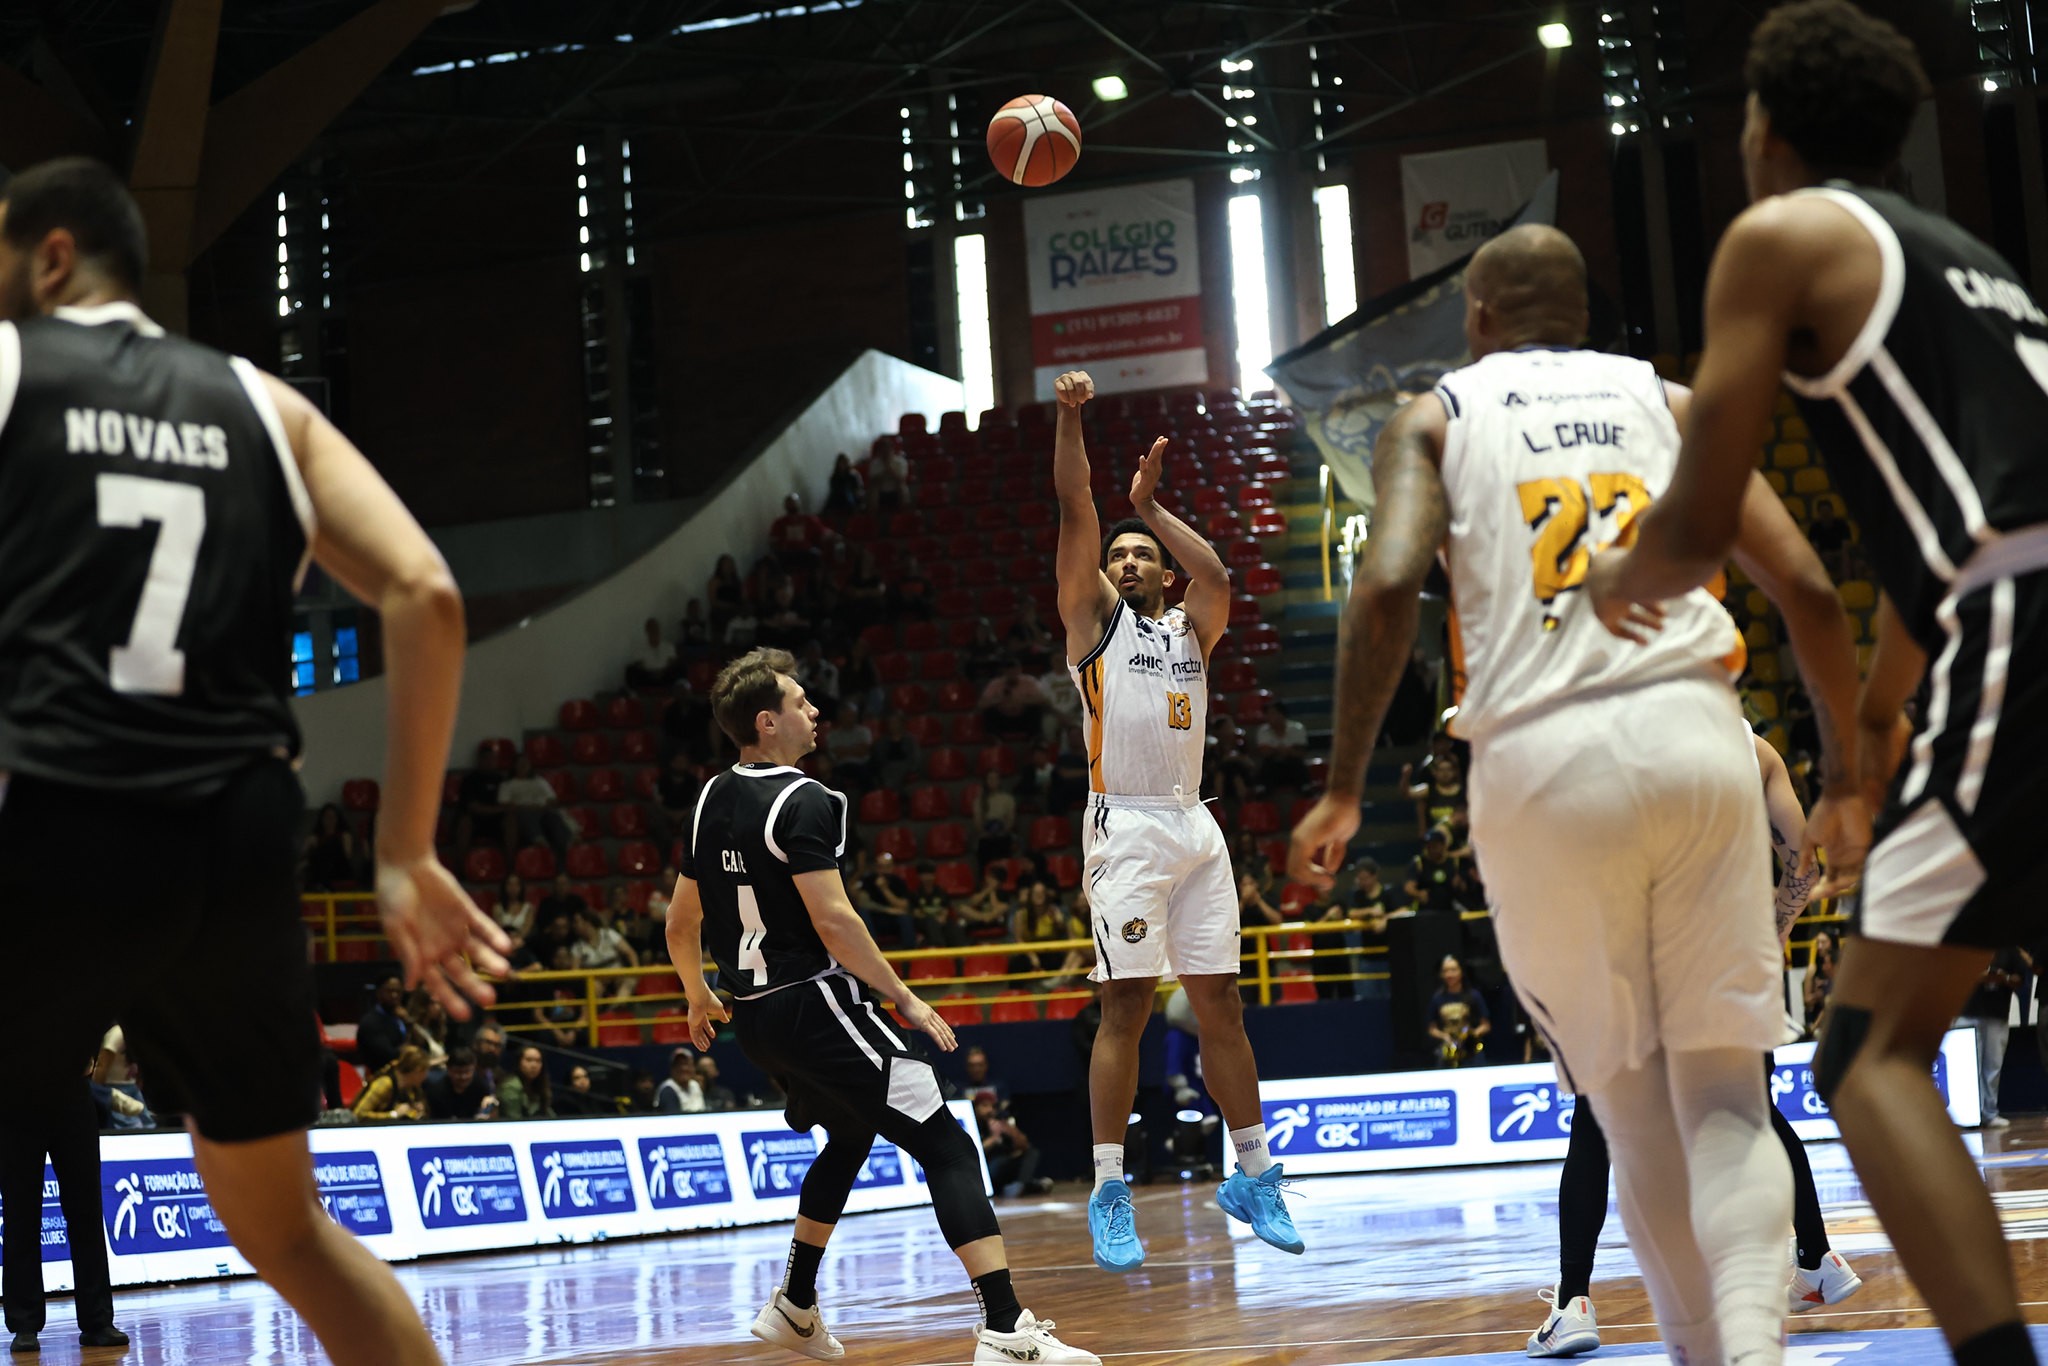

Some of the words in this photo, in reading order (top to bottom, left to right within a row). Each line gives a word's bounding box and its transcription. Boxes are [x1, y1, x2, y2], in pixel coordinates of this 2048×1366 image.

[64, 407, 230, 470] NOVAES
[96, 472, 207, 696] 7
[1166, 691, 1192, 731] 13
[736, 884, 768, 987] 4
[1382, 1100, 1399, 1114] DE
[1400, 1097, 1451, 1113] ATLETAS
[153, 1204, 186, 1240] CBC
